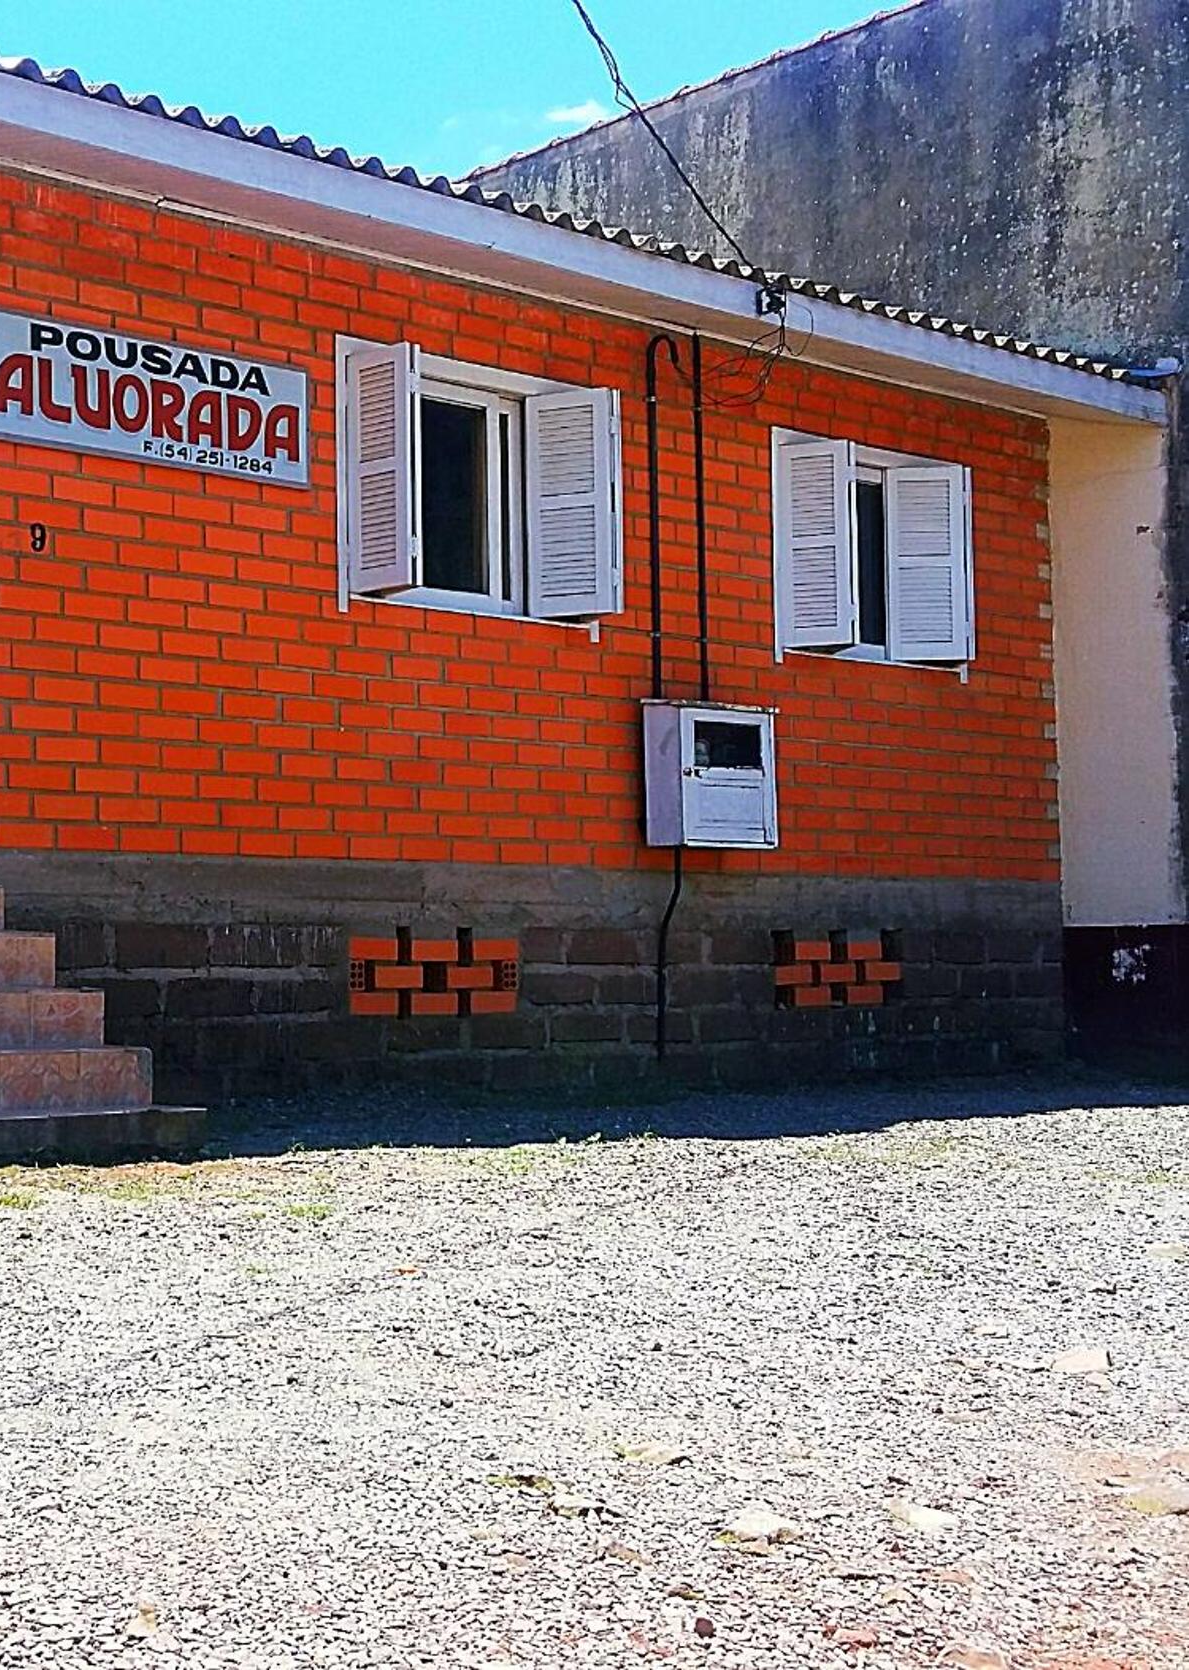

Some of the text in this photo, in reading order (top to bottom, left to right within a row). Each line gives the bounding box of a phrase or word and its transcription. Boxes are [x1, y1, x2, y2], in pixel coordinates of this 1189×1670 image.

[30, 322, 272, 397] POUSADA
[196, 449, 273, 475] 251-1284
[30, 522, 47, 553] 9
